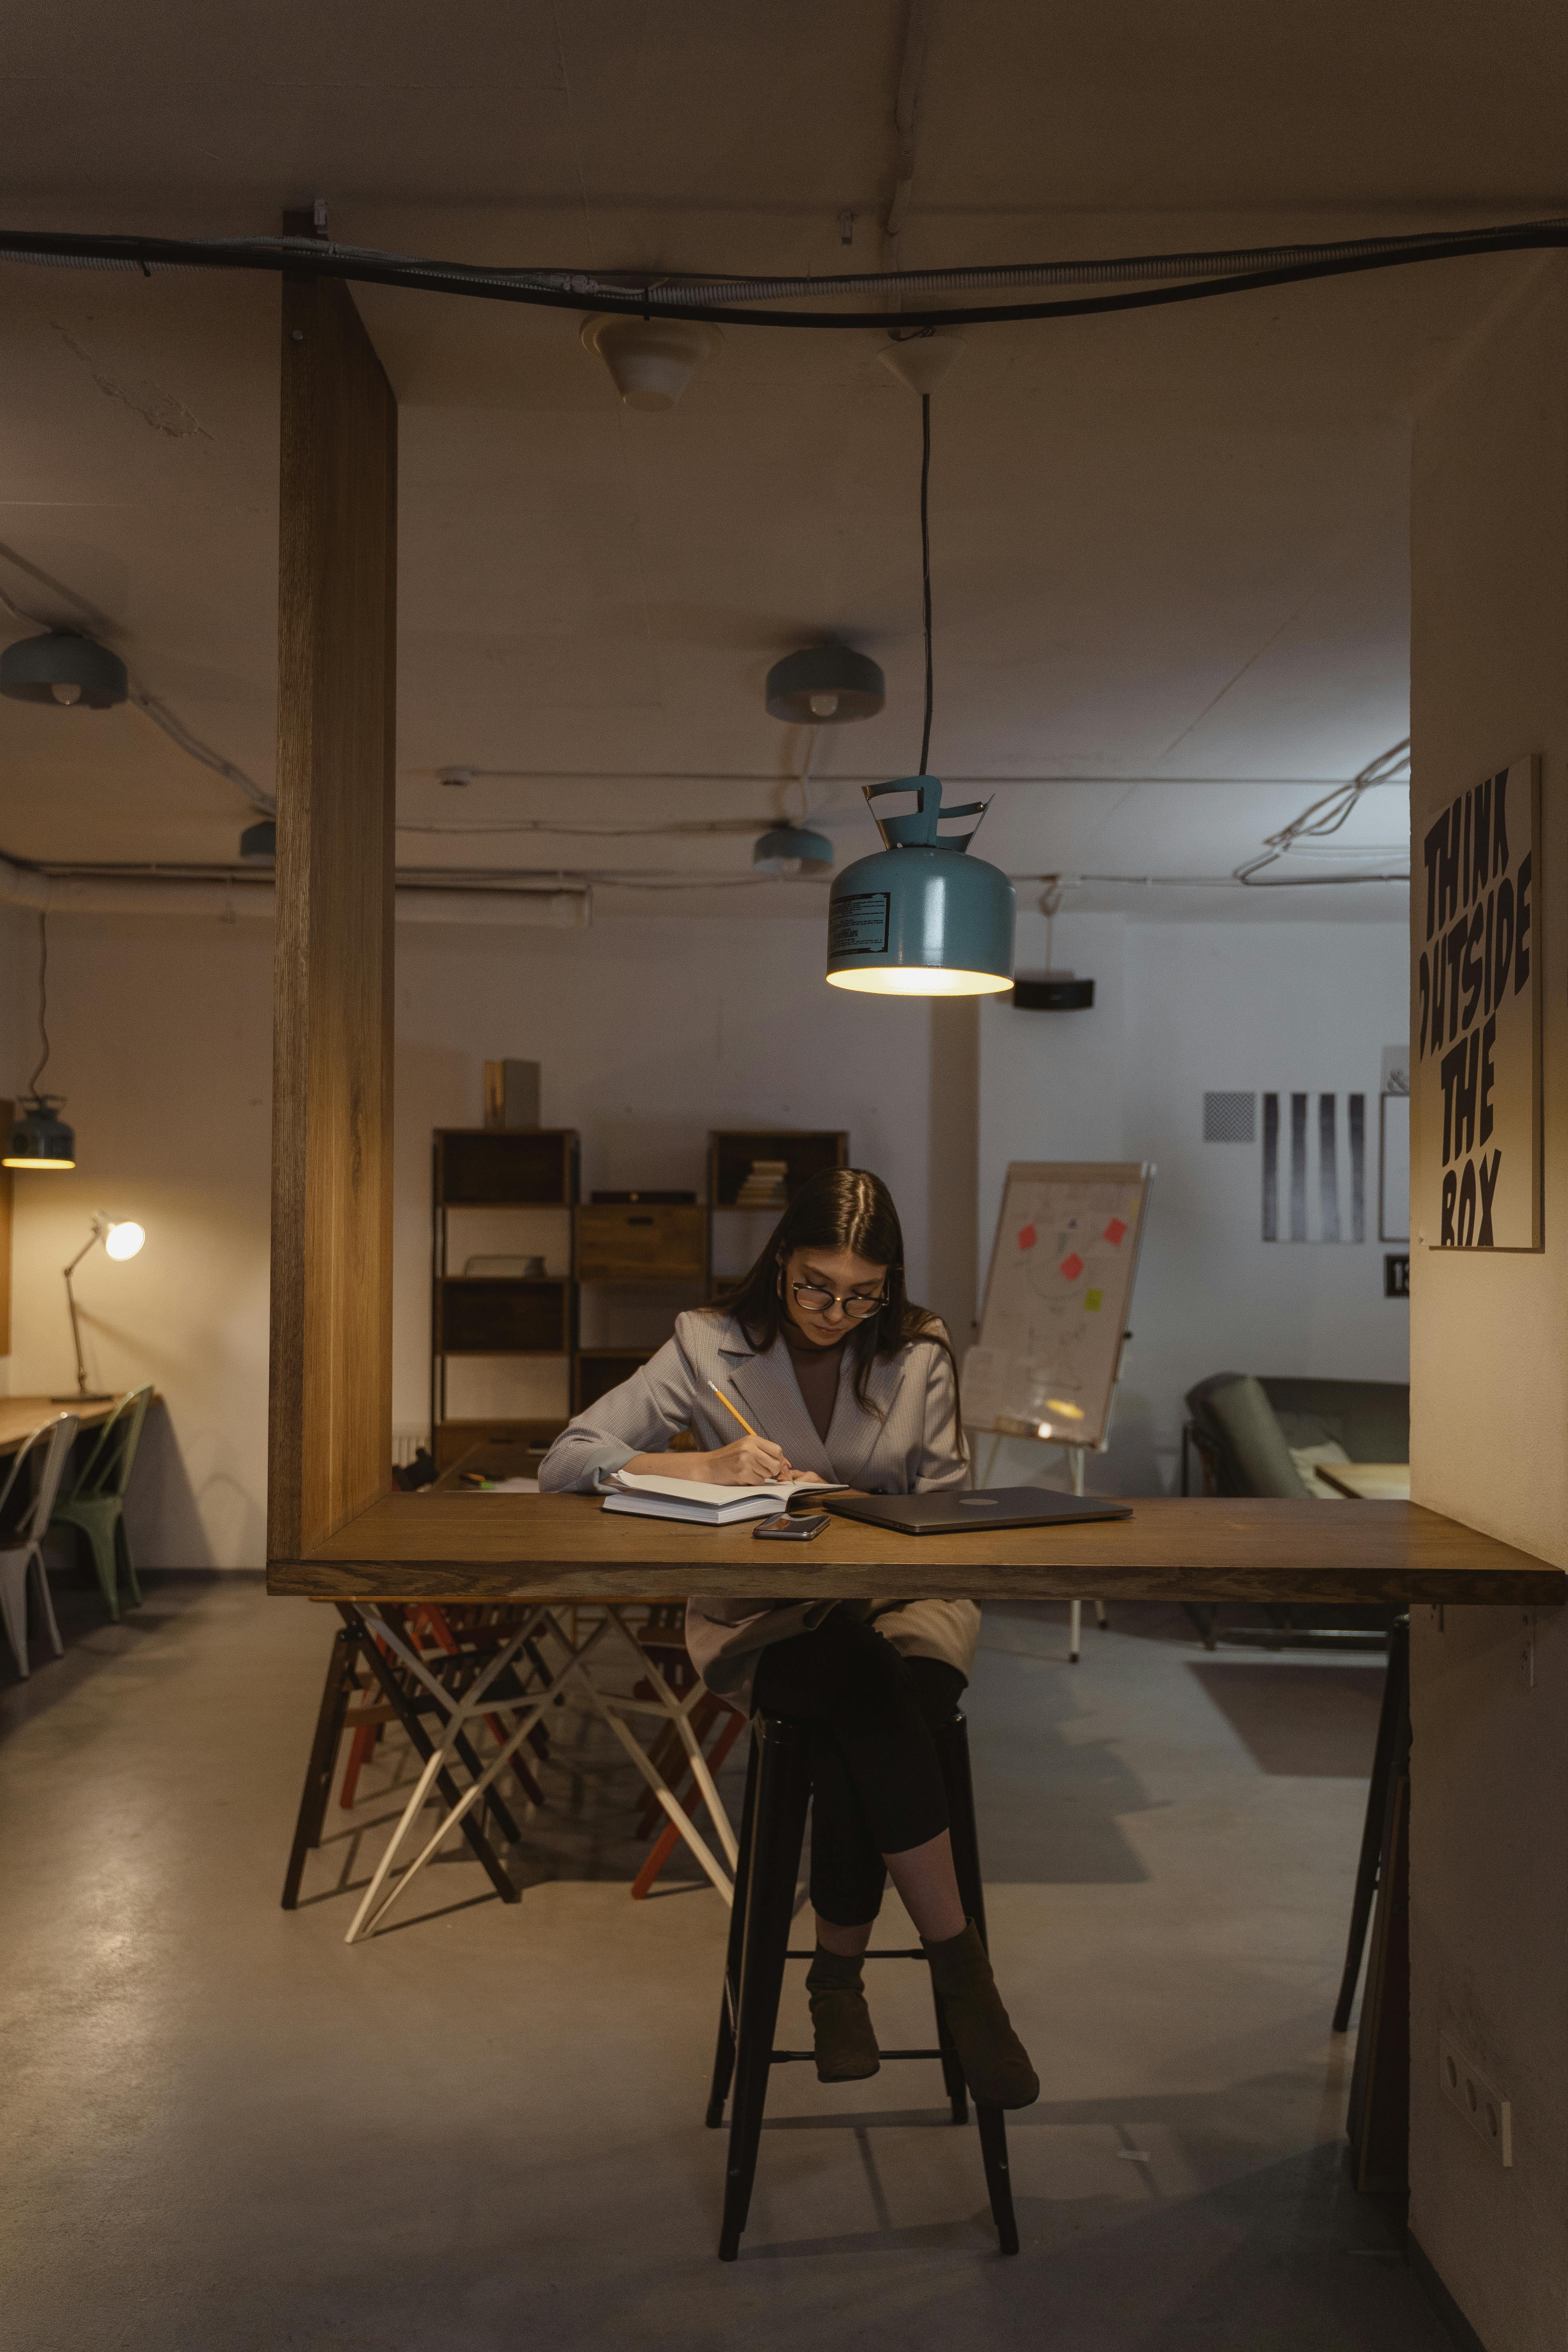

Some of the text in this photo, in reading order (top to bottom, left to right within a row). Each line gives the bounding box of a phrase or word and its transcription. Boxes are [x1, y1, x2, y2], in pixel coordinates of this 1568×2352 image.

[1424, 767, 1510, 942] THINK
[1441, 1012, 1496, 1167] THE
[1441, 1149, 1502, 1246] BOX
